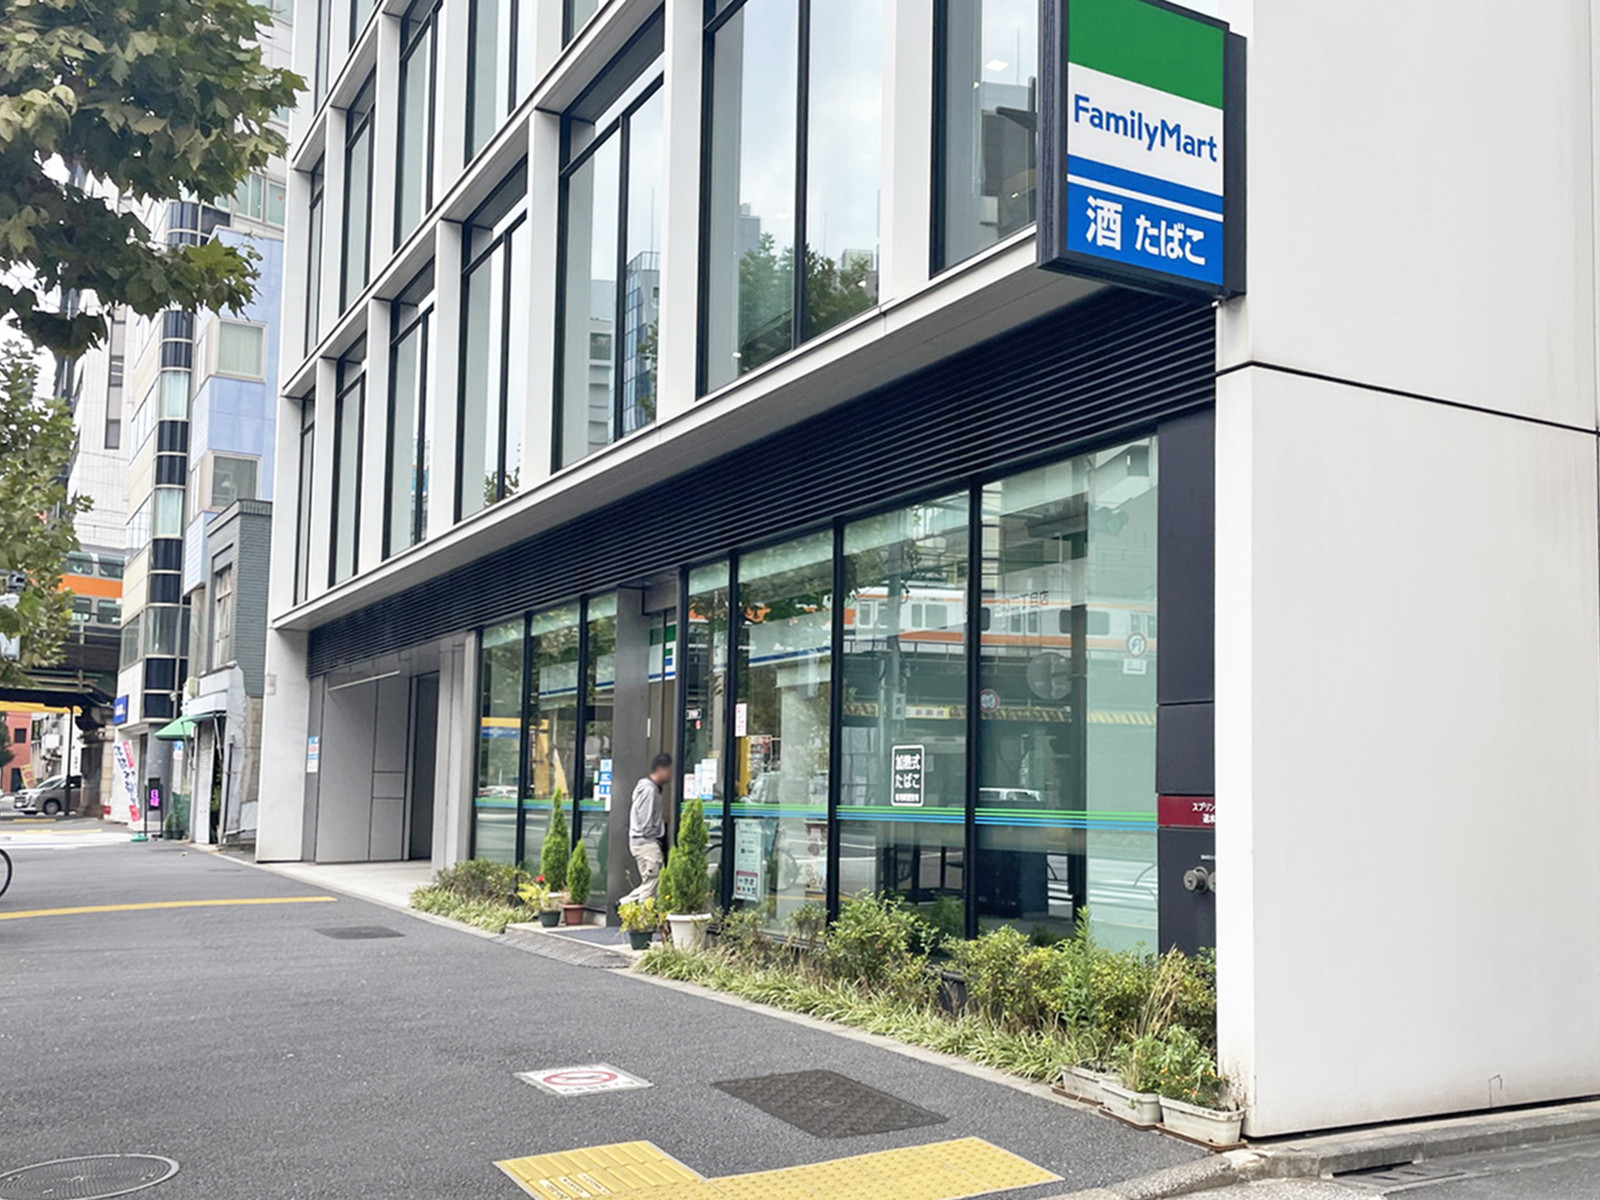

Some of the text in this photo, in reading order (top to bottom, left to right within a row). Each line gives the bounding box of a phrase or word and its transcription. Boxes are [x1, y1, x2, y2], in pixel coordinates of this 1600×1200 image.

[1074, 94, 1217, 162] FamilyMart
[1086, 195, 1206, 266] 酒 たばこ
[895, 773, 921, 789] たばこ
